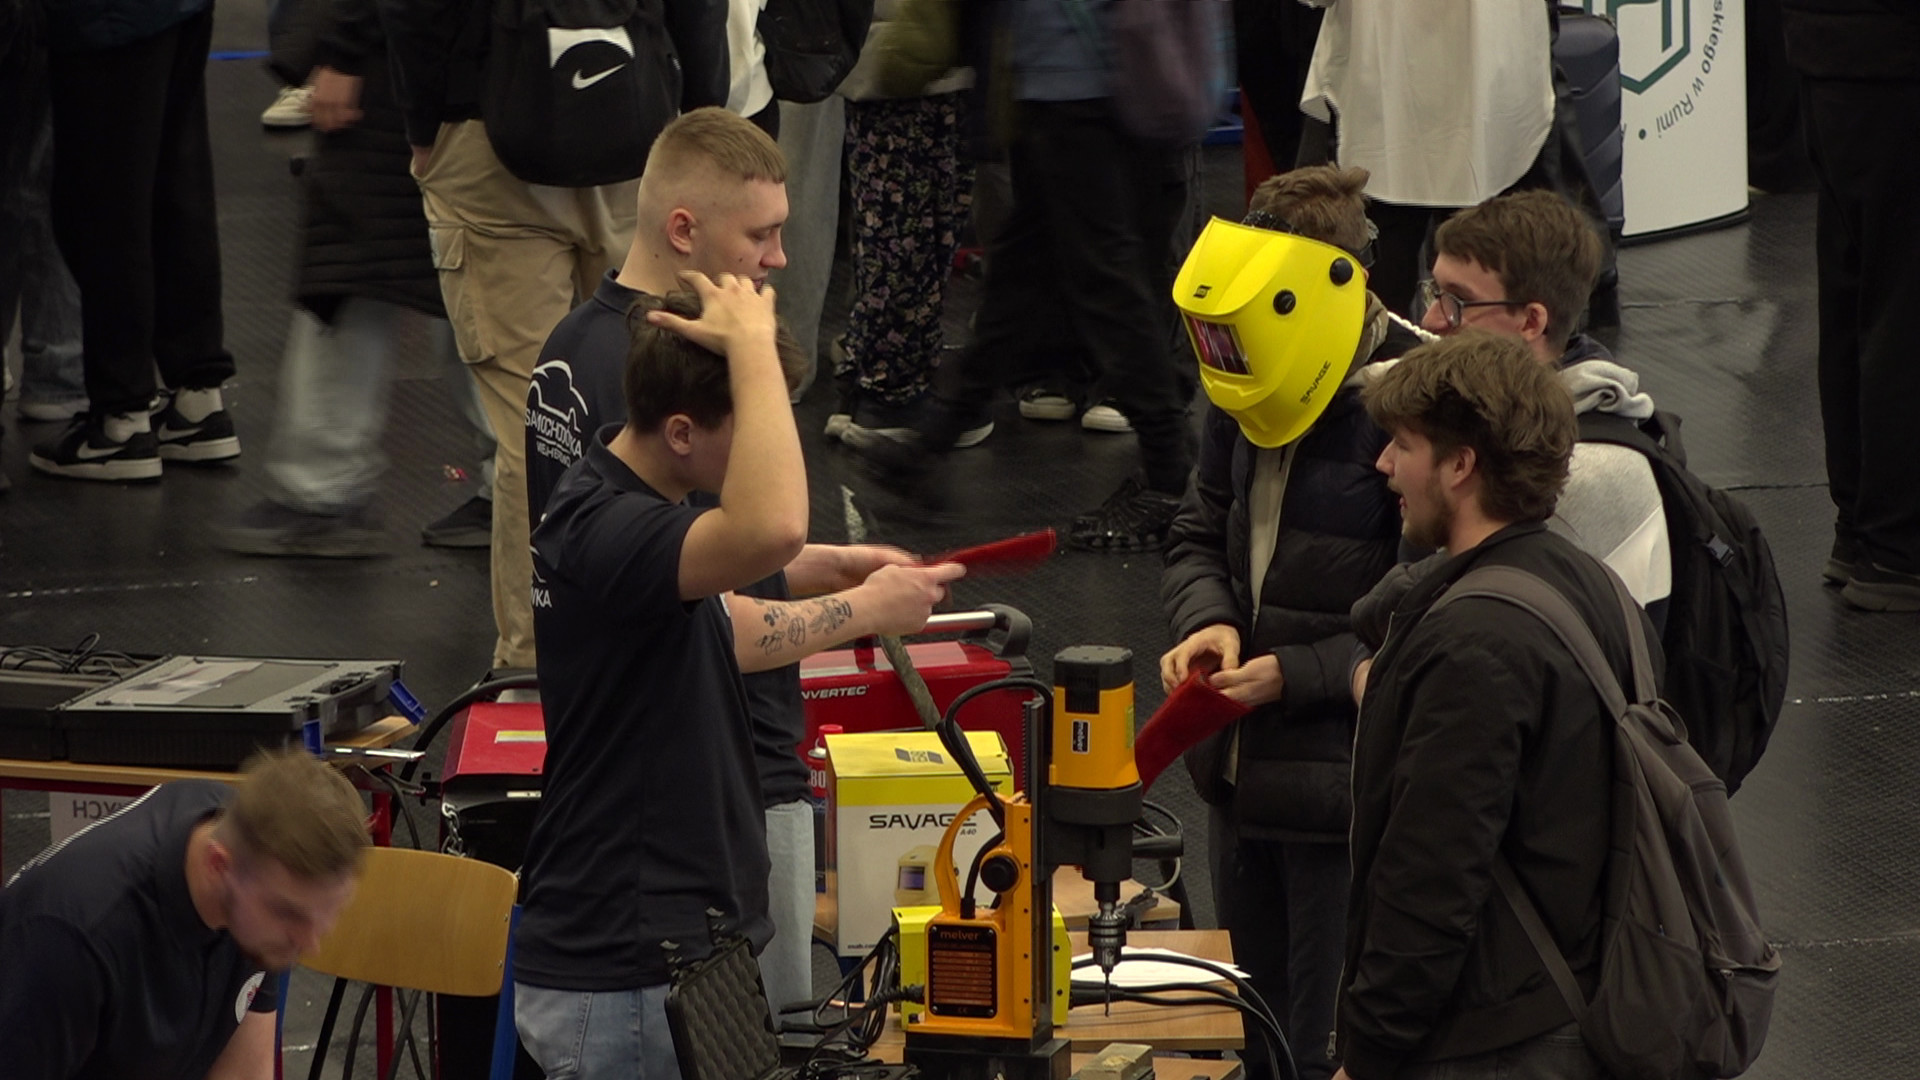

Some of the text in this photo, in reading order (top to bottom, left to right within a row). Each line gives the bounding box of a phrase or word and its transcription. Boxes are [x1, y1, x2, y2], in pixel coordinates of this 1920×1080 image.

[1692, 76, 1704, 97] w
[1656, 93, 1694, 138] Rumi
[1300, 359, 1331, 403] SAVAGE
[801, 686, 866, 699] NVERTEC
[940, 930, 979, 940] melver
